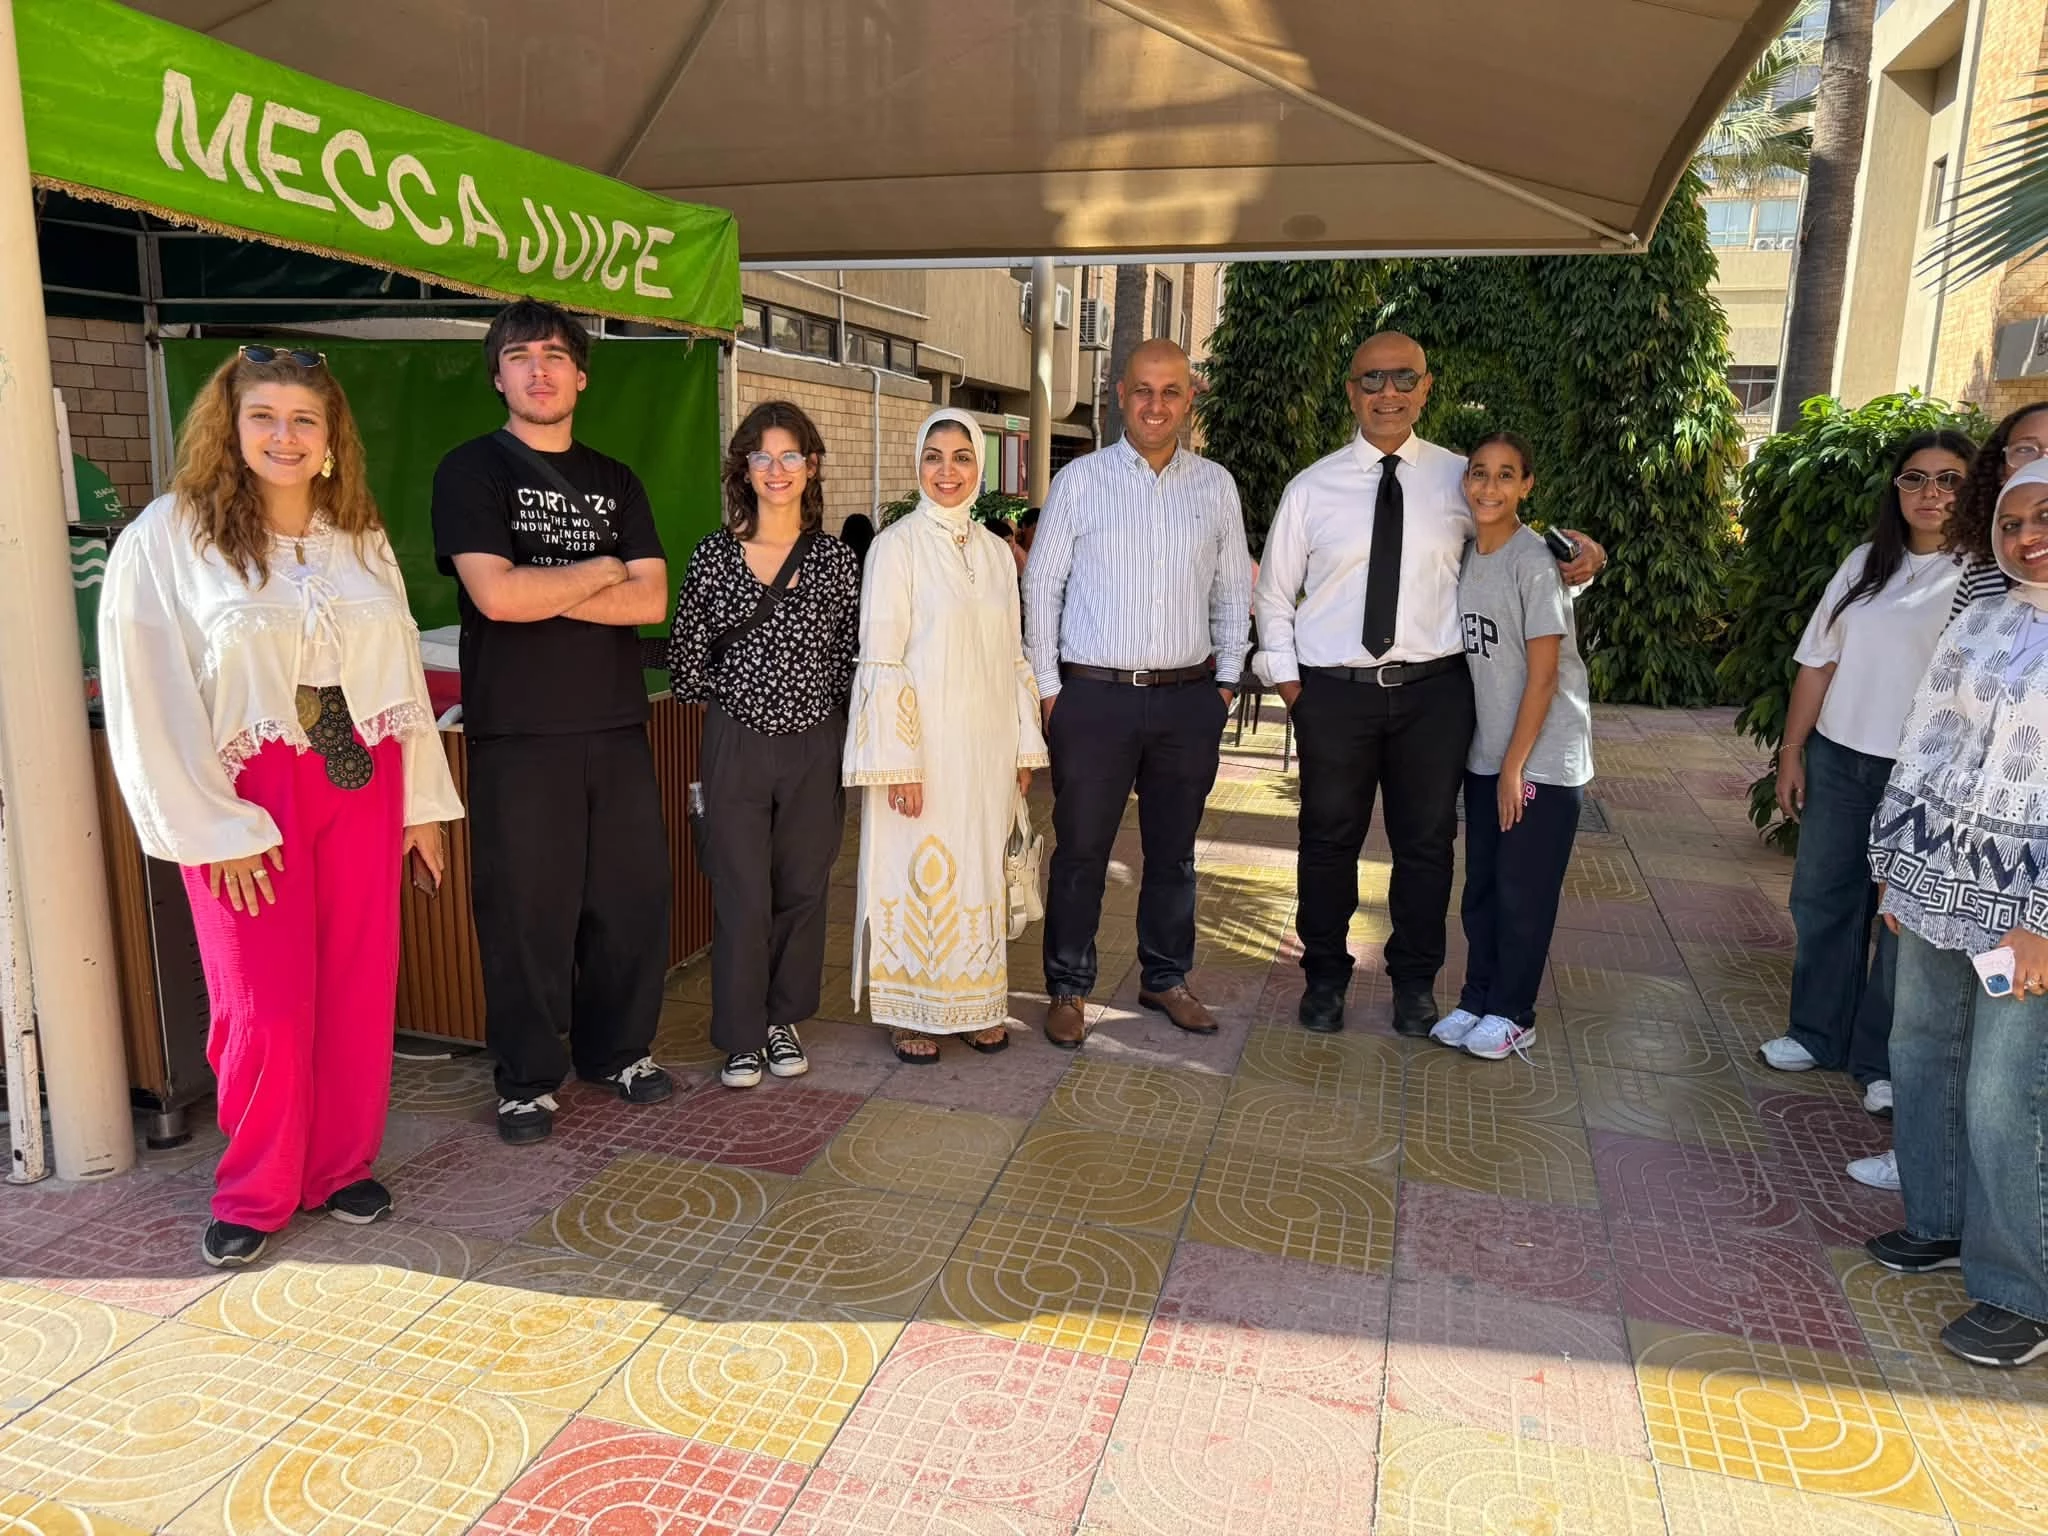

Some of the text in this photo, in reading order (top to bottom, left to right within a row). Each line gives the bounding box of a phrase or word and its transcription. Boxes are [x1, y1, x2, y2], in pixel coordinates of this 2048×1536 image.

[156, 69, 676, 299] MECCA JUICE
[520, 510, 548, 520] RULE
[550, 515, 567, 527] THE
[566, 541, 595, 551] 2018
[1460, 612, 1499, 660] EP
